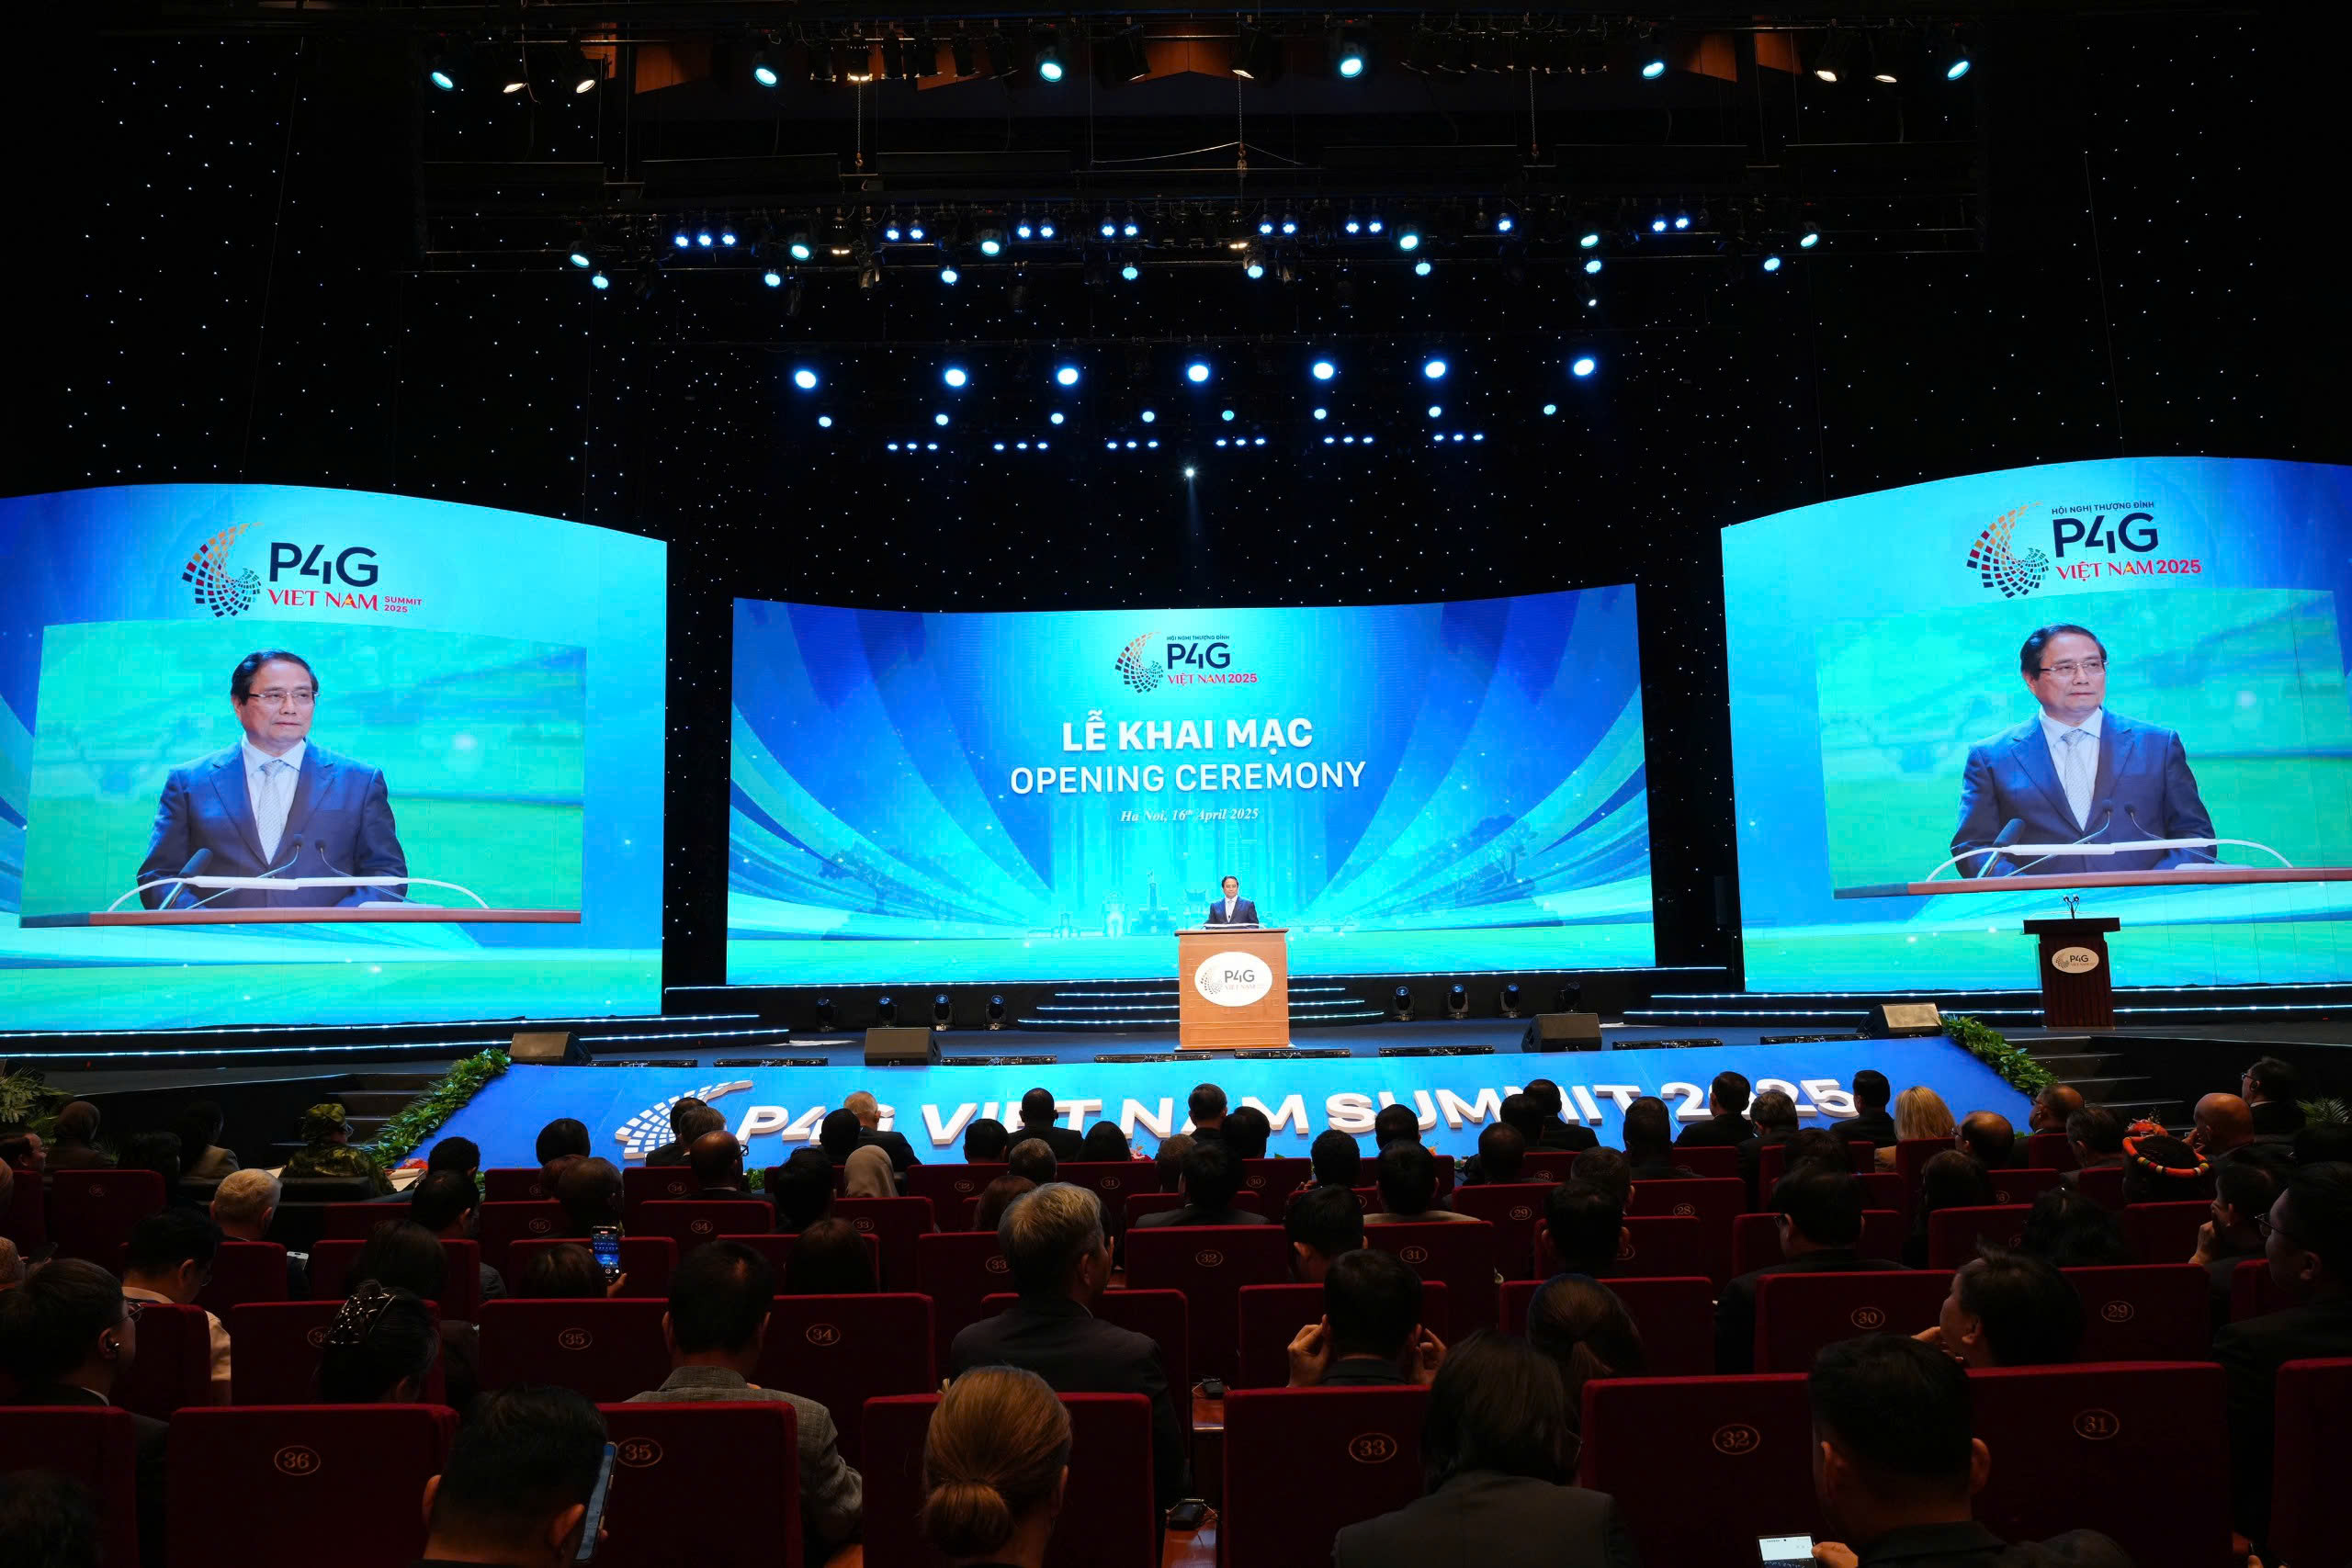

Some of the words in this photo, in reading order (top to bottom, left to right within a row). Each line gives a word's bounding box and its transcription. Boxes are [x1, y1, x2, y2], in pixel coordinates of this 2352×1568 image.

[2052, 512, 2159, 558] P4G
[268, 541, 379, 588] P4G
[2055, 560, 2100, 581] VIỆT
[2108, 559, 2154, 577] NAM
[2156, 559, 2201, 574] 2025
[267, 588, 321, 608] VIET
[325, 591, 379, 612] NAM
[384, 595, 423, 605] SUMMIT
[384, 604, 408, 613] 2025
[1167, 642, 1231, 670] P4G
[1168, 672, 1194, 687] VIỆT
[1197, 673, 1227, 684] NAM
[1227, 673, 1258, 683] 2025
[1062, 709, 1106, 751] LỄ
[1118, 720, 1214, 750] KHAI
[1227, 717, 1314, 755] MẠC
[1011, 764, 1165, 795] OPENING
[1174, 761, 1367, 792] CEREMONY
[1197, 808, 1227, 823] April
[1229, 807, 1260, 820] 2025
[2069, 954, 2089, 963] P4G
[1224, 969, 1255, 983] P4G
[735, 1105, 896, 1145] P4
[1120, 1094, 1309, 1139] NM
[1660, 1078, 1860, 1122] 225
[1104, 1179, 1114, 1187] 31
[1514, 1209, 1528, 1217] 29
[1677, 1205, 1691, 1214] 28
[695, 1223, 708, 1231] 34
[856, 1221, 868, 1229] 33
[1200, 1253, 1217, 1264] 32
[1406, 1250, 1419, 1259] 31
[991, 1259, 1007, 1269] 33
[1858, 1312, 1878, 1324] 30
[2108, 1304, 2128, 1318] 29
[566, 1333, 585, 1345] 35
[812, 1328, 832, 1340] 34
[2086, 1416, 2108, 1433] 31
[1723, 1431, 1749, 1448] 32
[625, 1443, 652, 1461] 35
[1360, 1439, 1385, 1456] 33
[284, 1451, 310, 1470] 36
